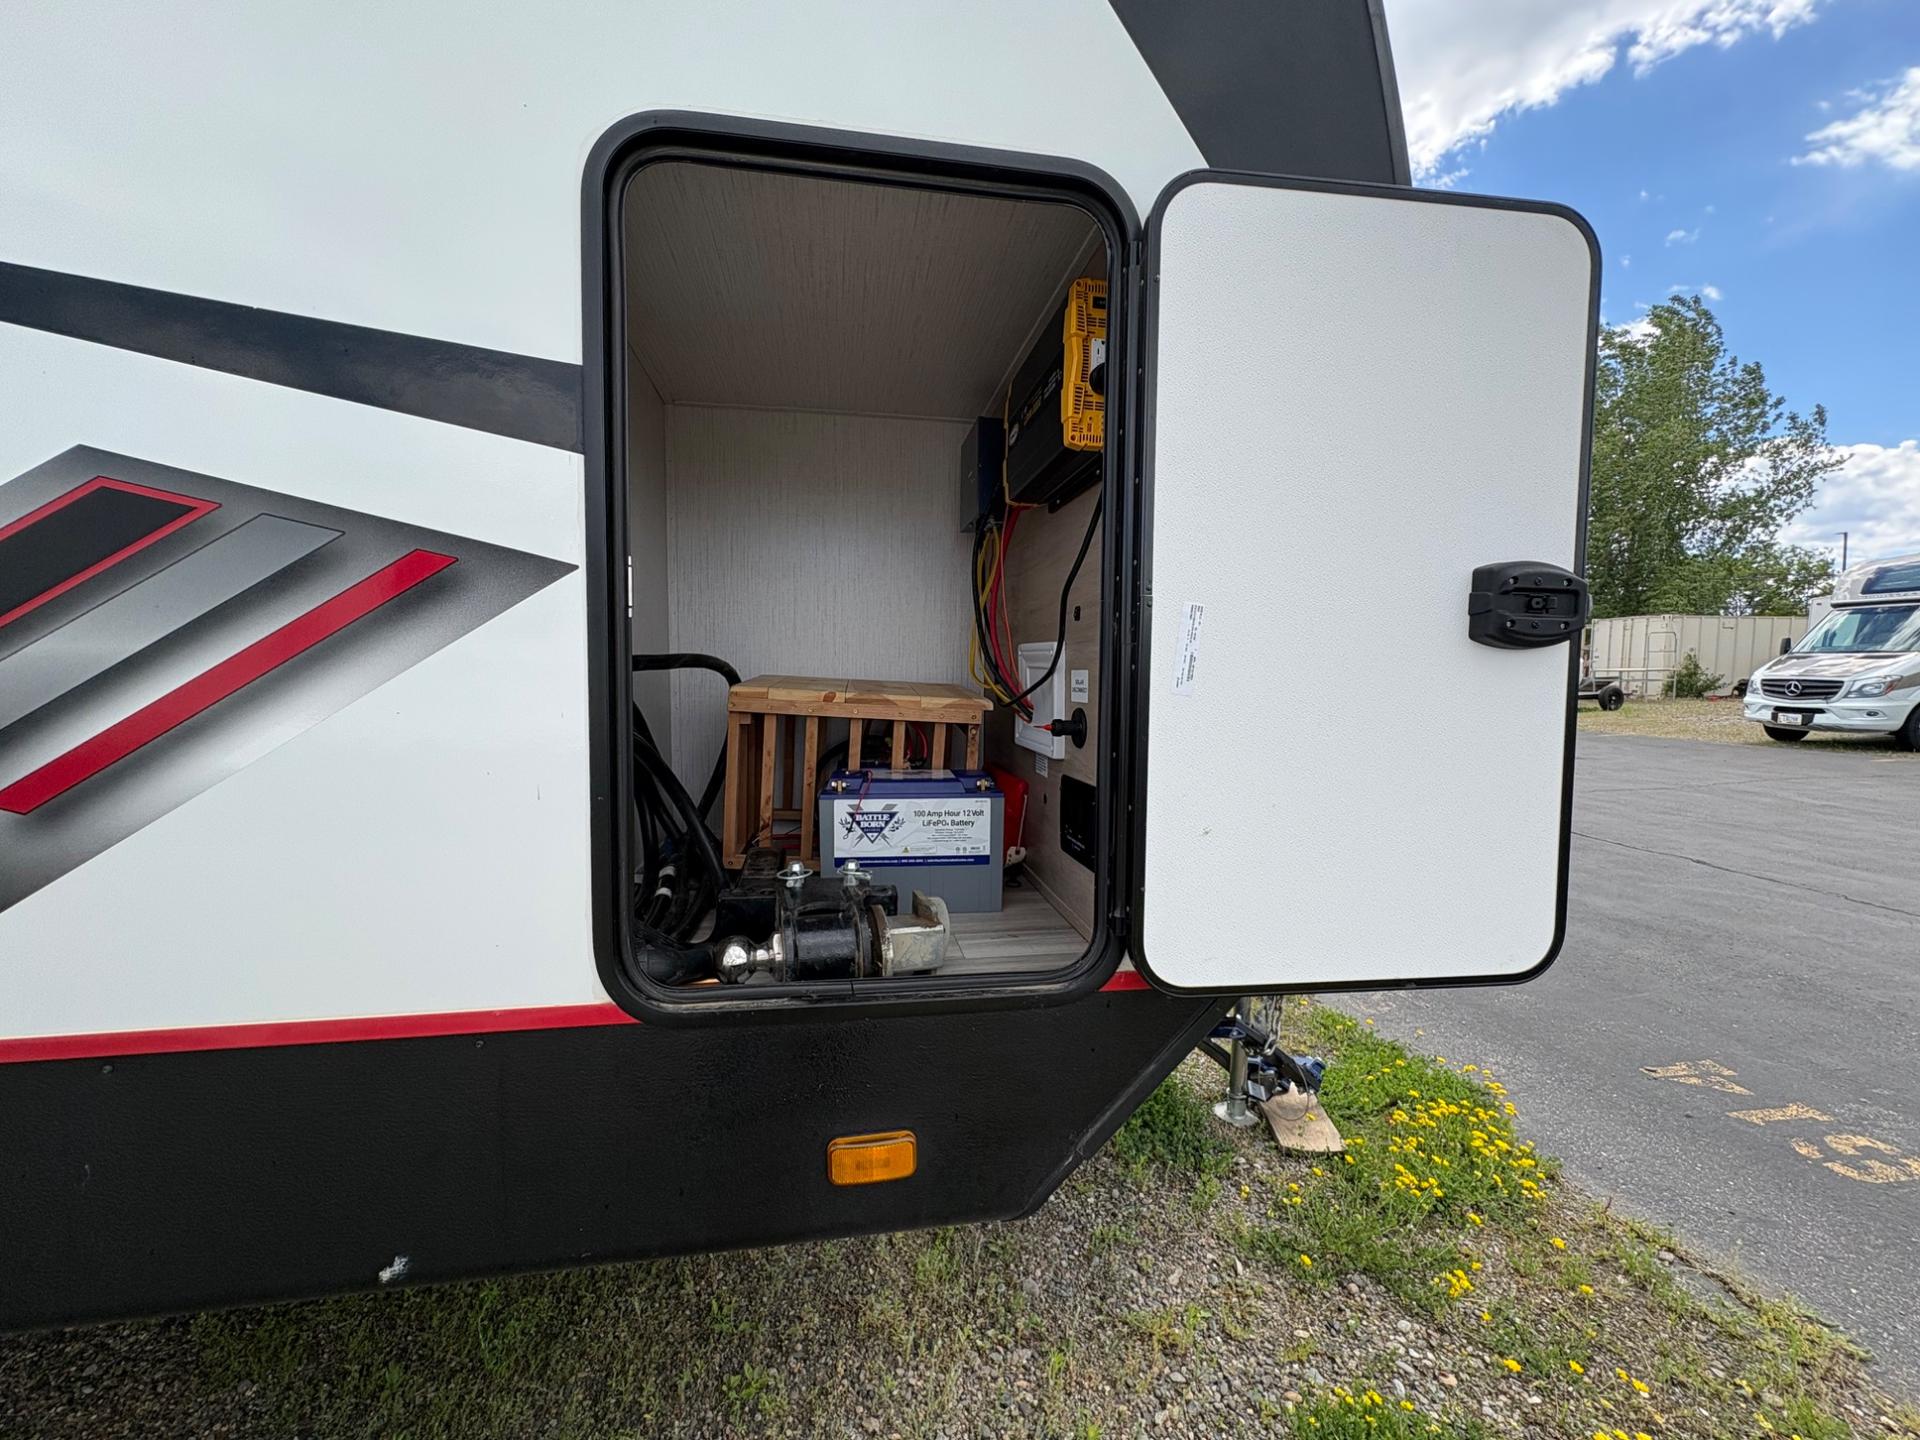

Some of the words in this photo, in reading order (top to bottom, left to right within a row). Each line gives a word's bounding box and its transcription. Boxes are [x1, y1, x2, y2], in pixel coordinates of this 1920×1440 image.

[927, 810, 943, 818] Amp
[962, 809, 971, 817] 12
[971, 809, 985, 817] Volt
[860, 820, 886, 828] BORN
[950, 819, 976, 828] Battery
